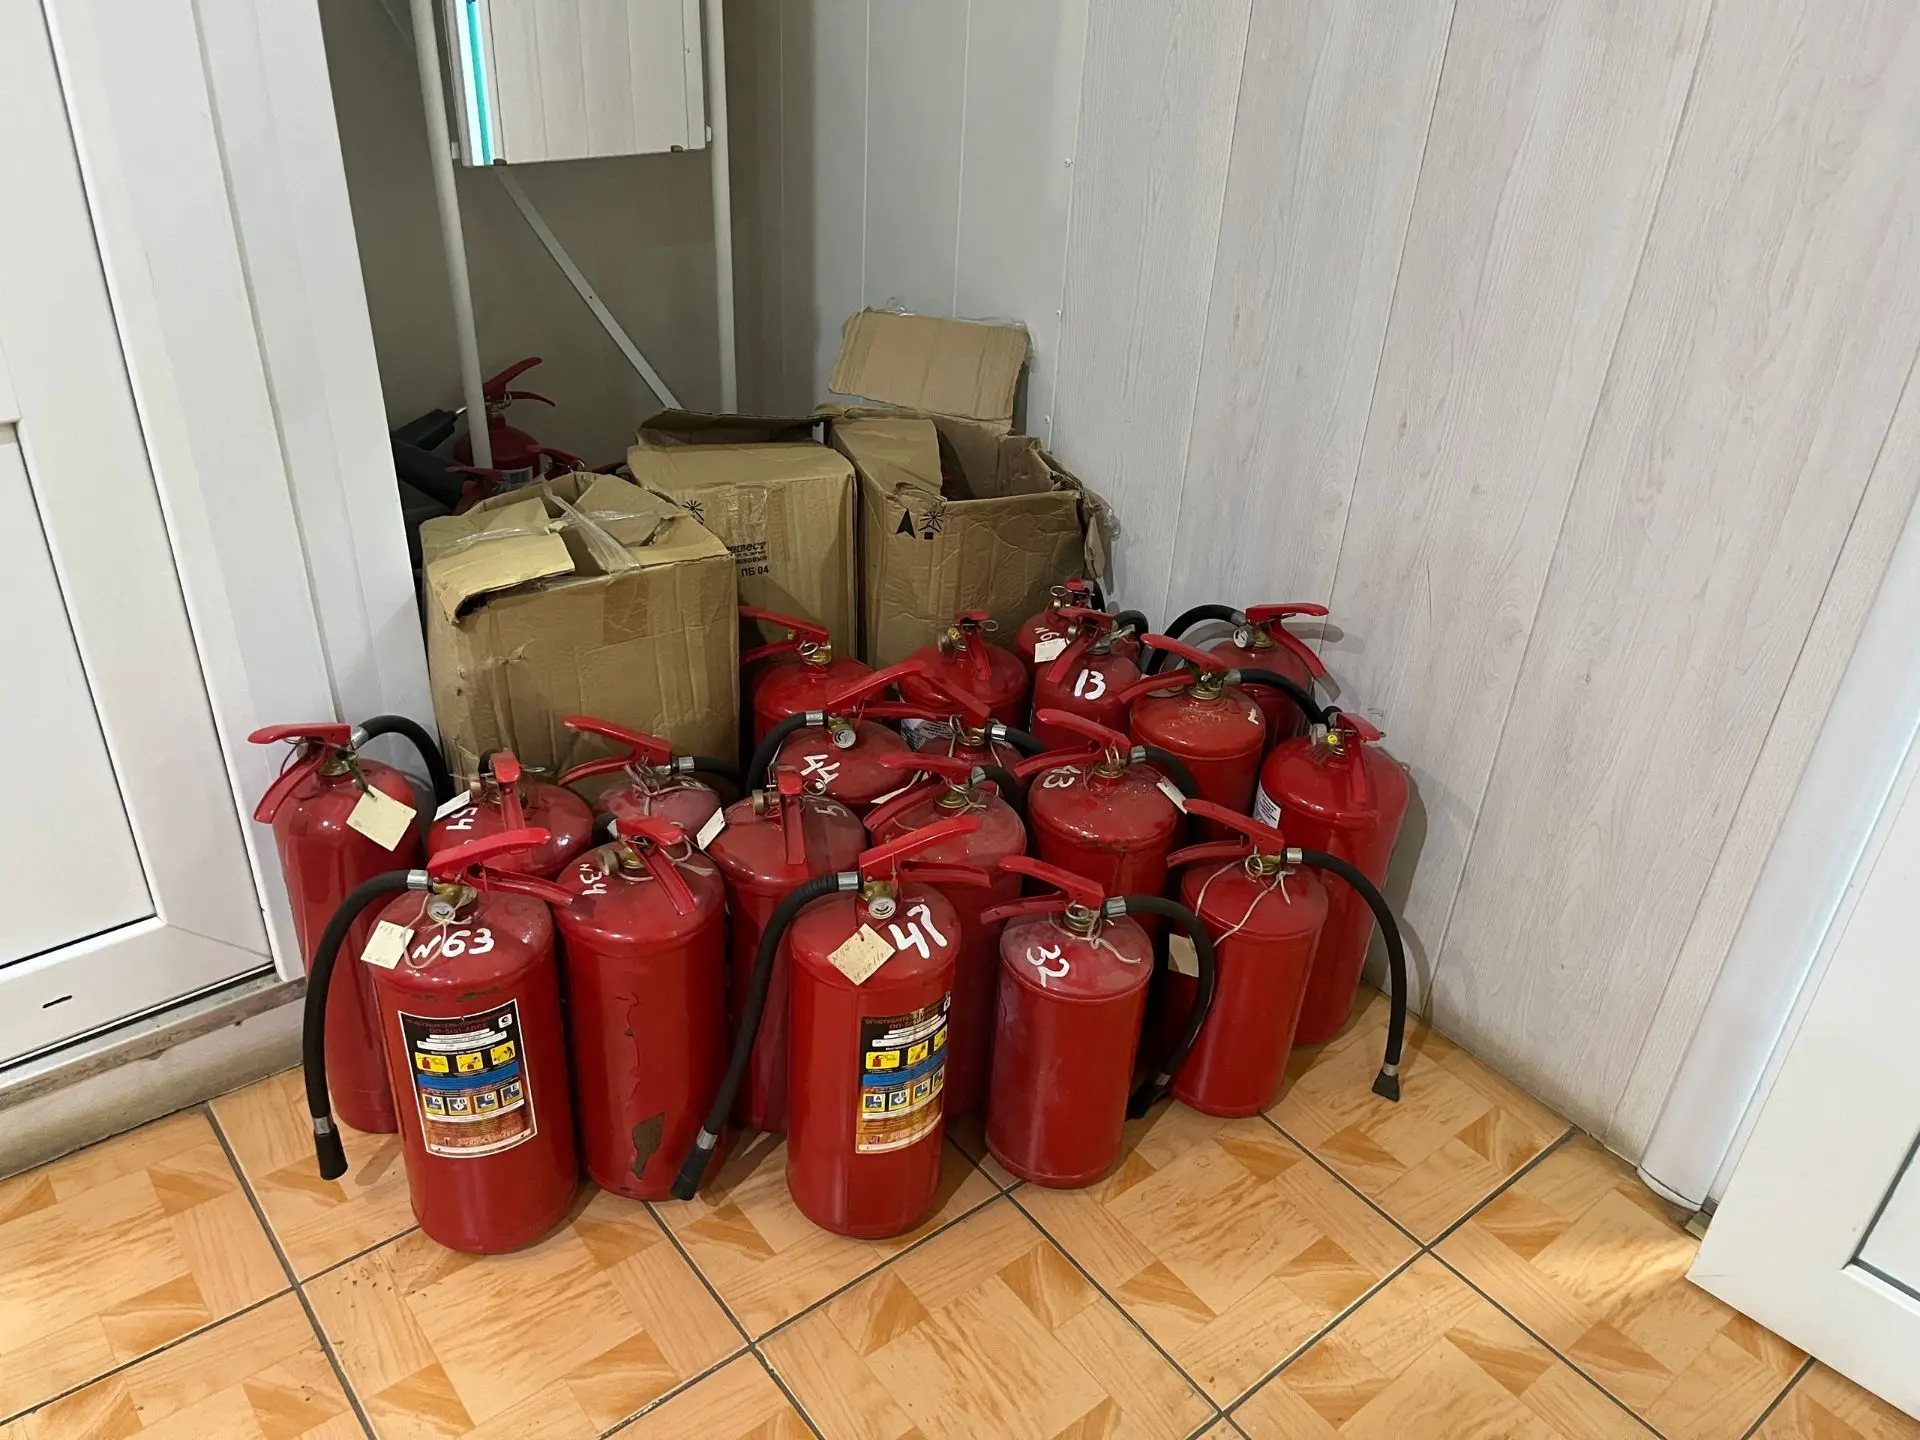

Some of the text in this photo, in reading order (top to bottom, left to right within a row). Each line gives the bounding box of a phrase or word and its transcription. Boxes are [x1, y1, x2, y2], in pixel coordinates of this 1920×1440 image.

[1074, 668, 1106, 700] 13
[888, 903, 948, 959] 47
[1026, 945, 1071, 988] 32
